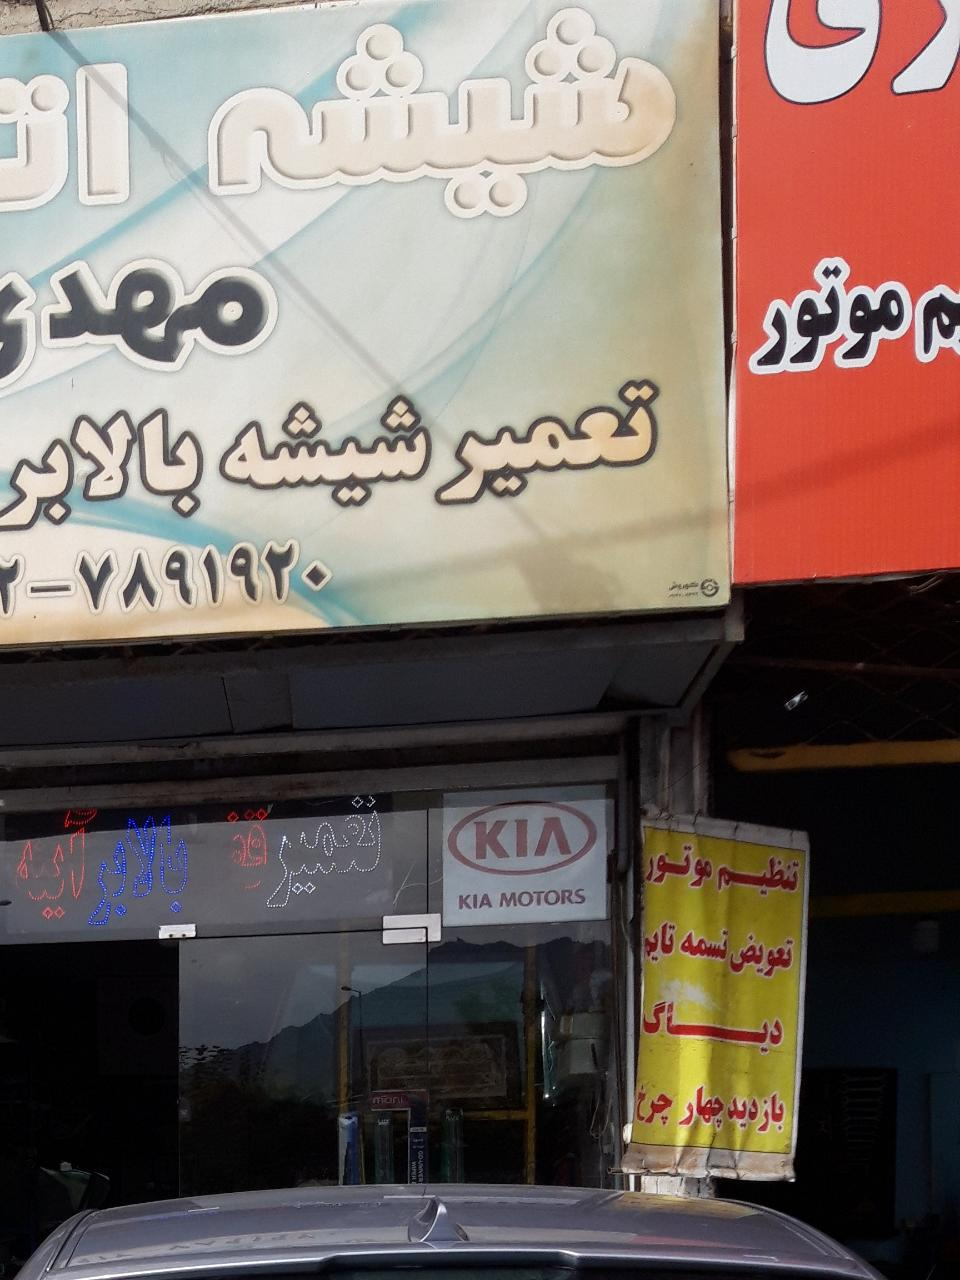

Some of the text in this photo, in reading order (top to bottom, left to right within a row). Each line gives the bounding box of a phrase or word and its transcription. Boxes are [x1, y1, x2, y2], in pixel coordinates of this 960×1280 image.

[208, 8, 676, 218] شیشه
[751, 259, 910, 372] موتور
[219, 395, 431, 507] شیشه
[435, 380, 659, 504] تعمیر
[473, 816, 573, 860] KIA
[717, 856, 800, 896] تنظیم
[458, 888, 587, 910] KIA MOTORS
[680, 929, 728, 961] تسمه
[730, 934, 794, 977] تعویض
[643, 1002, 783, 1053] دیاگ
[678, 1085, 725, 1128] چهار
[726, 1092, 785, 1133] بازدید
